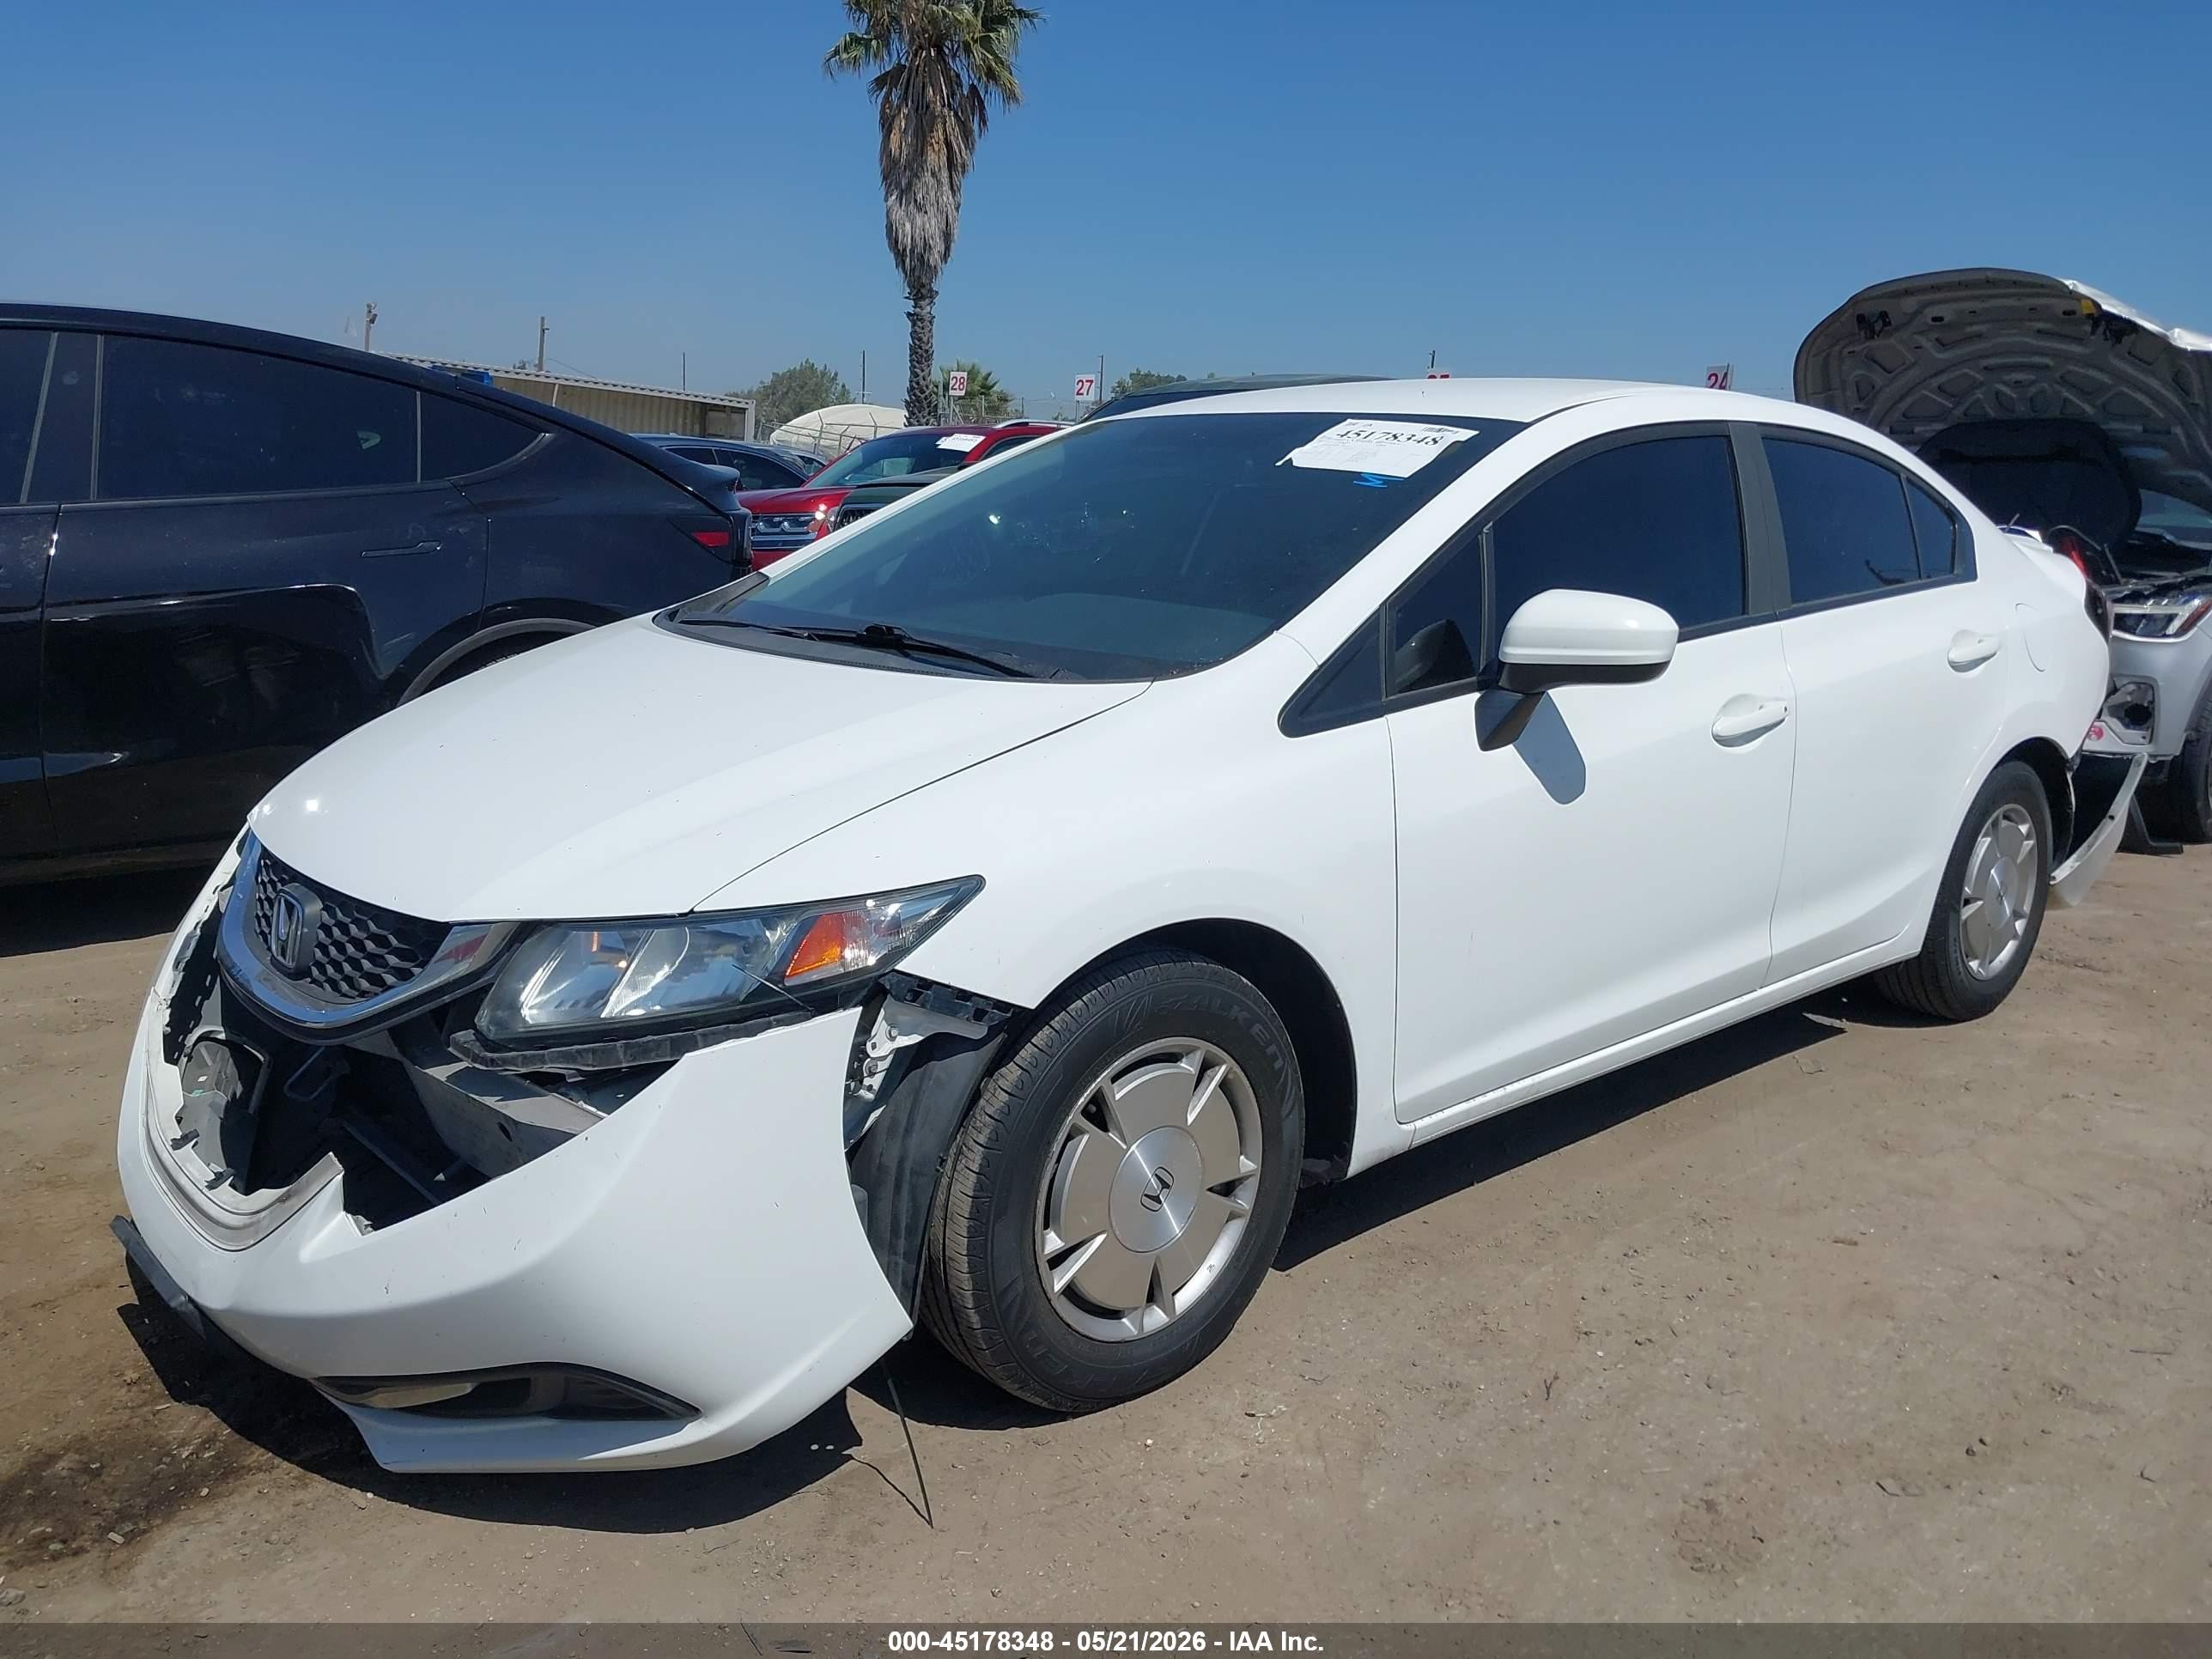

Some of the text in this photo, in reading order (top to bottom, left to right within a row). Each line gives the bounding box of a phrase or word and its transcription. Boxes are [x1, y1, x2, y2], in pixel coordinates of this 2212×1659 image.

[950, 376, 966, 391] 28
[1075, 379, 1094, 396] 27
[1336, 429, 1444, 446] 45178348
